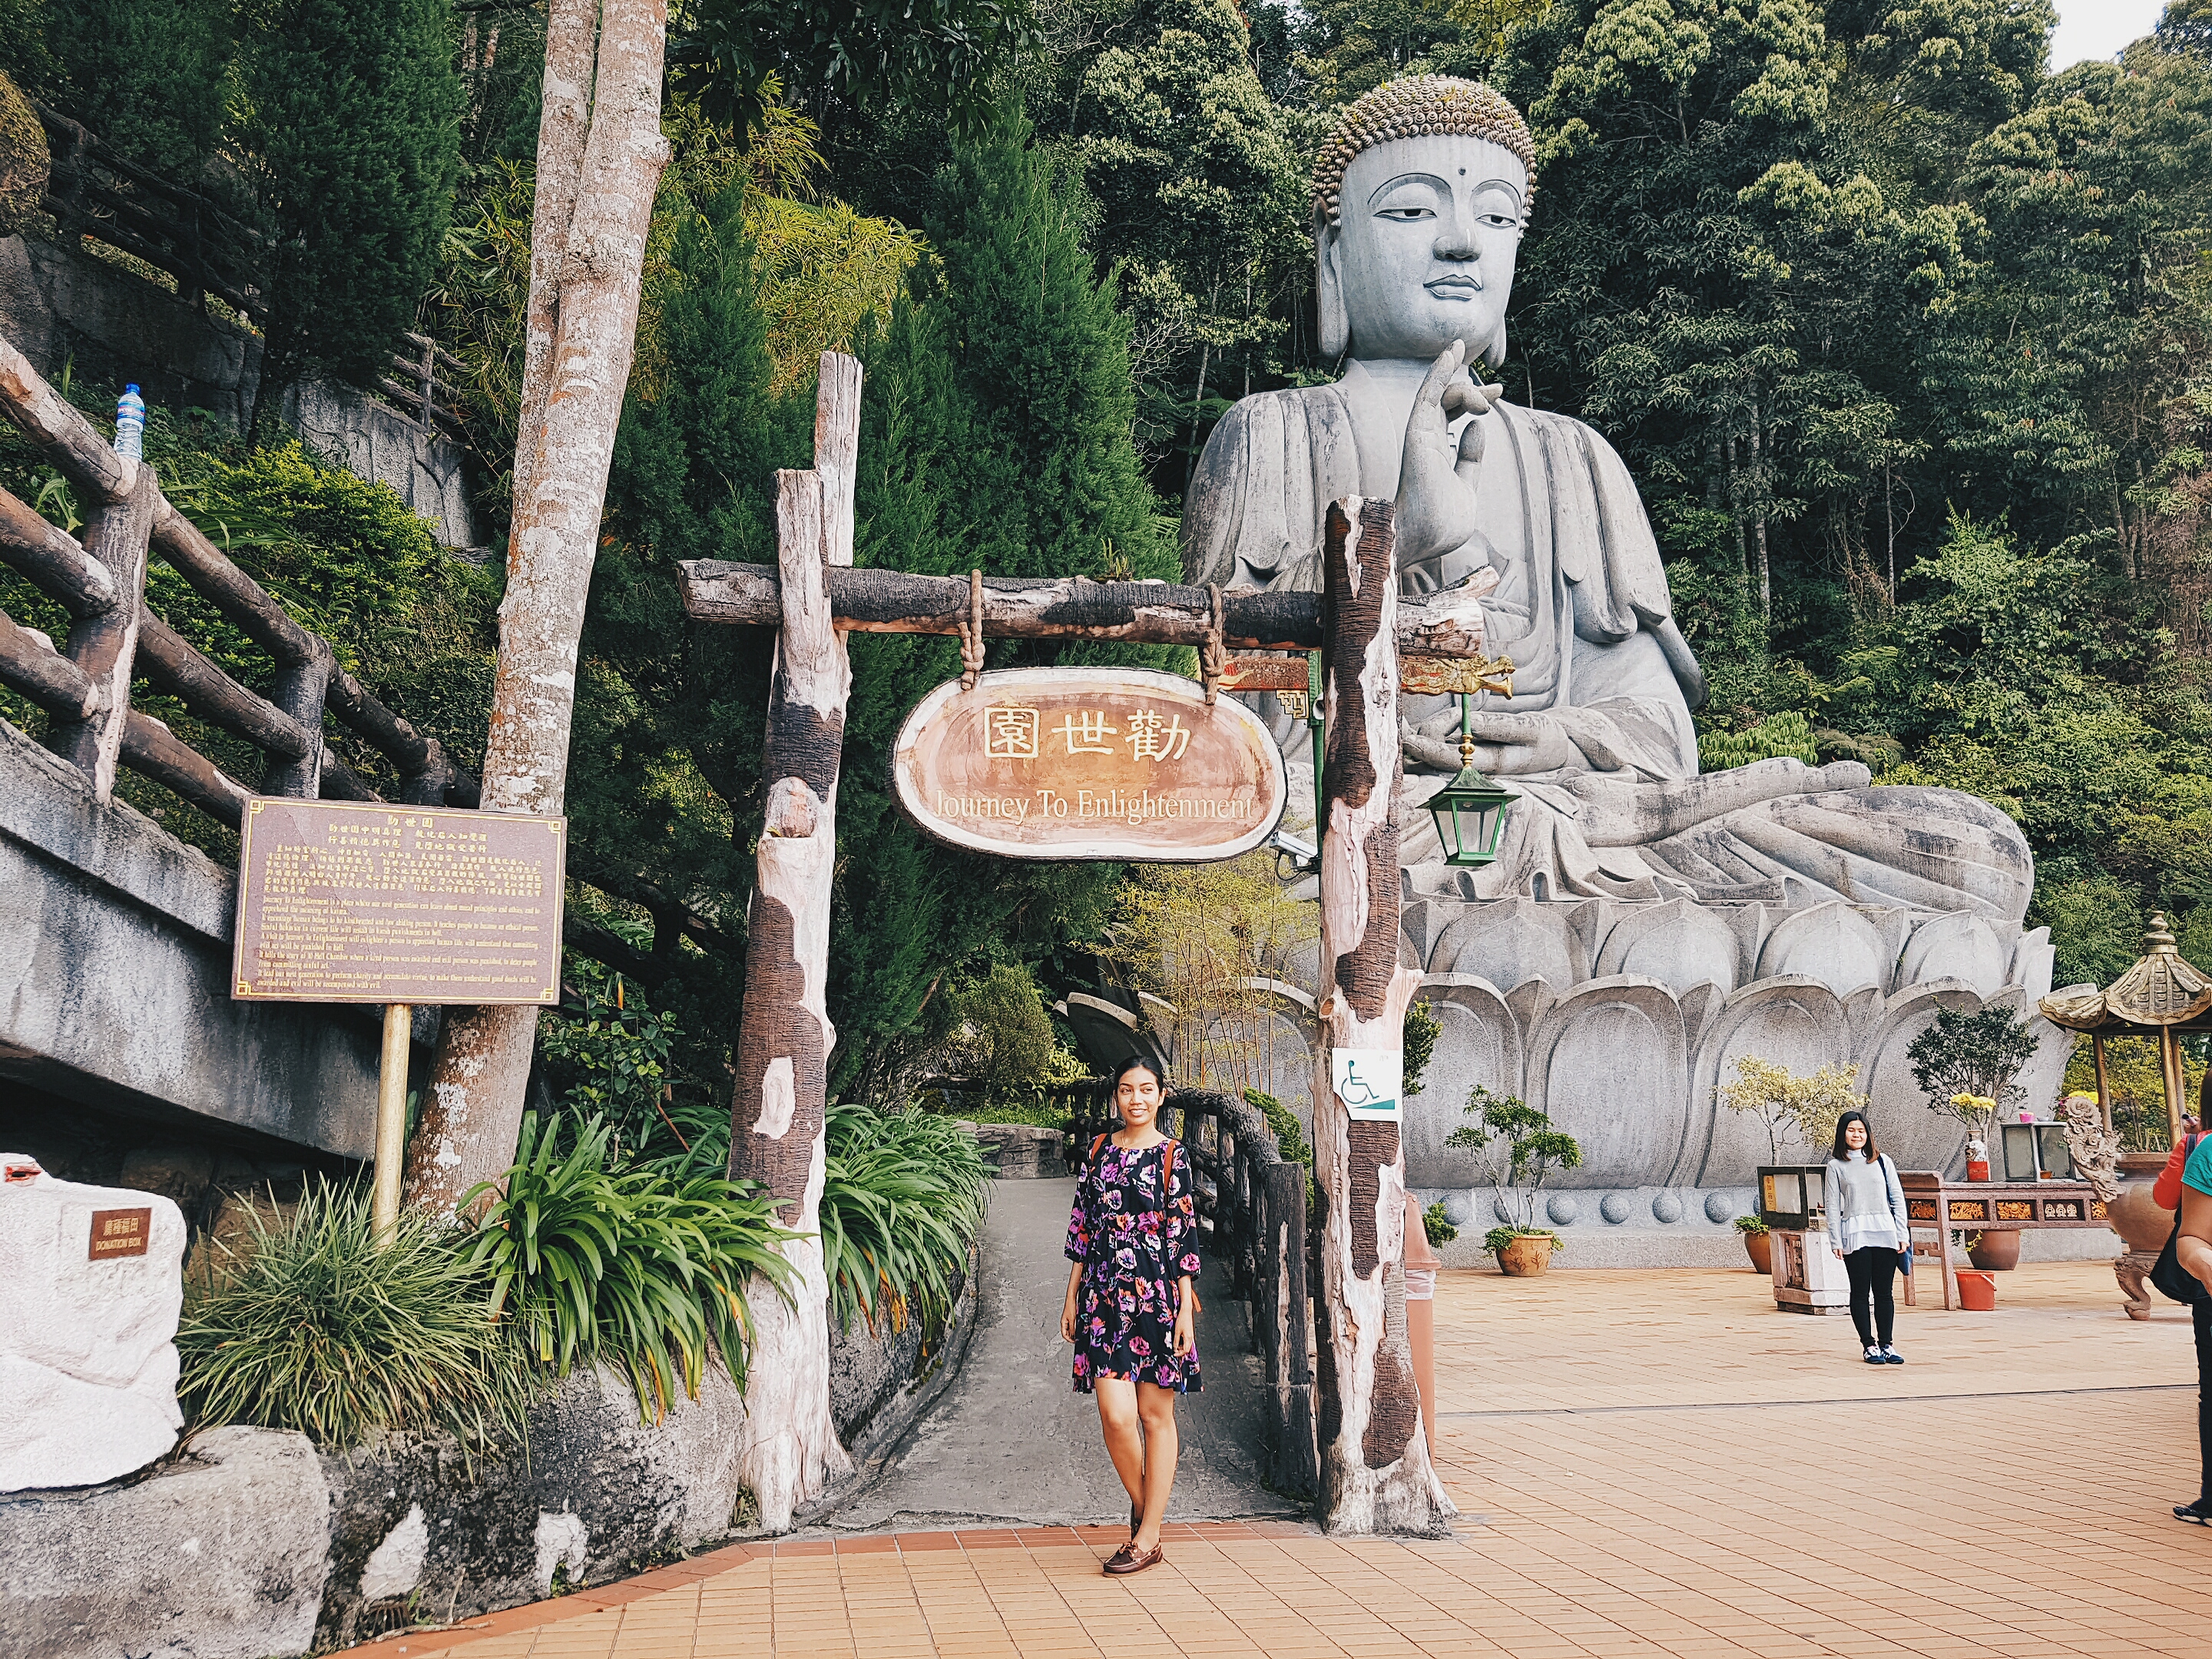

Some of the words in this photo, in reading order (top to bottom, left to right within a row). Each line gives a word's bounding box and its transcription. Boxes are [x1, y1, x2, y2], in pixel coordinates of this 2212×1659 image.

[934, 790, 1031, 826] Journey
[1037, 790, 1068, 820] To
[1078, 789, 1253, 826] Enlightenment
[95, 1238, 128, 1252] DONATION
[127, 1237, 142, 1247] BOX
